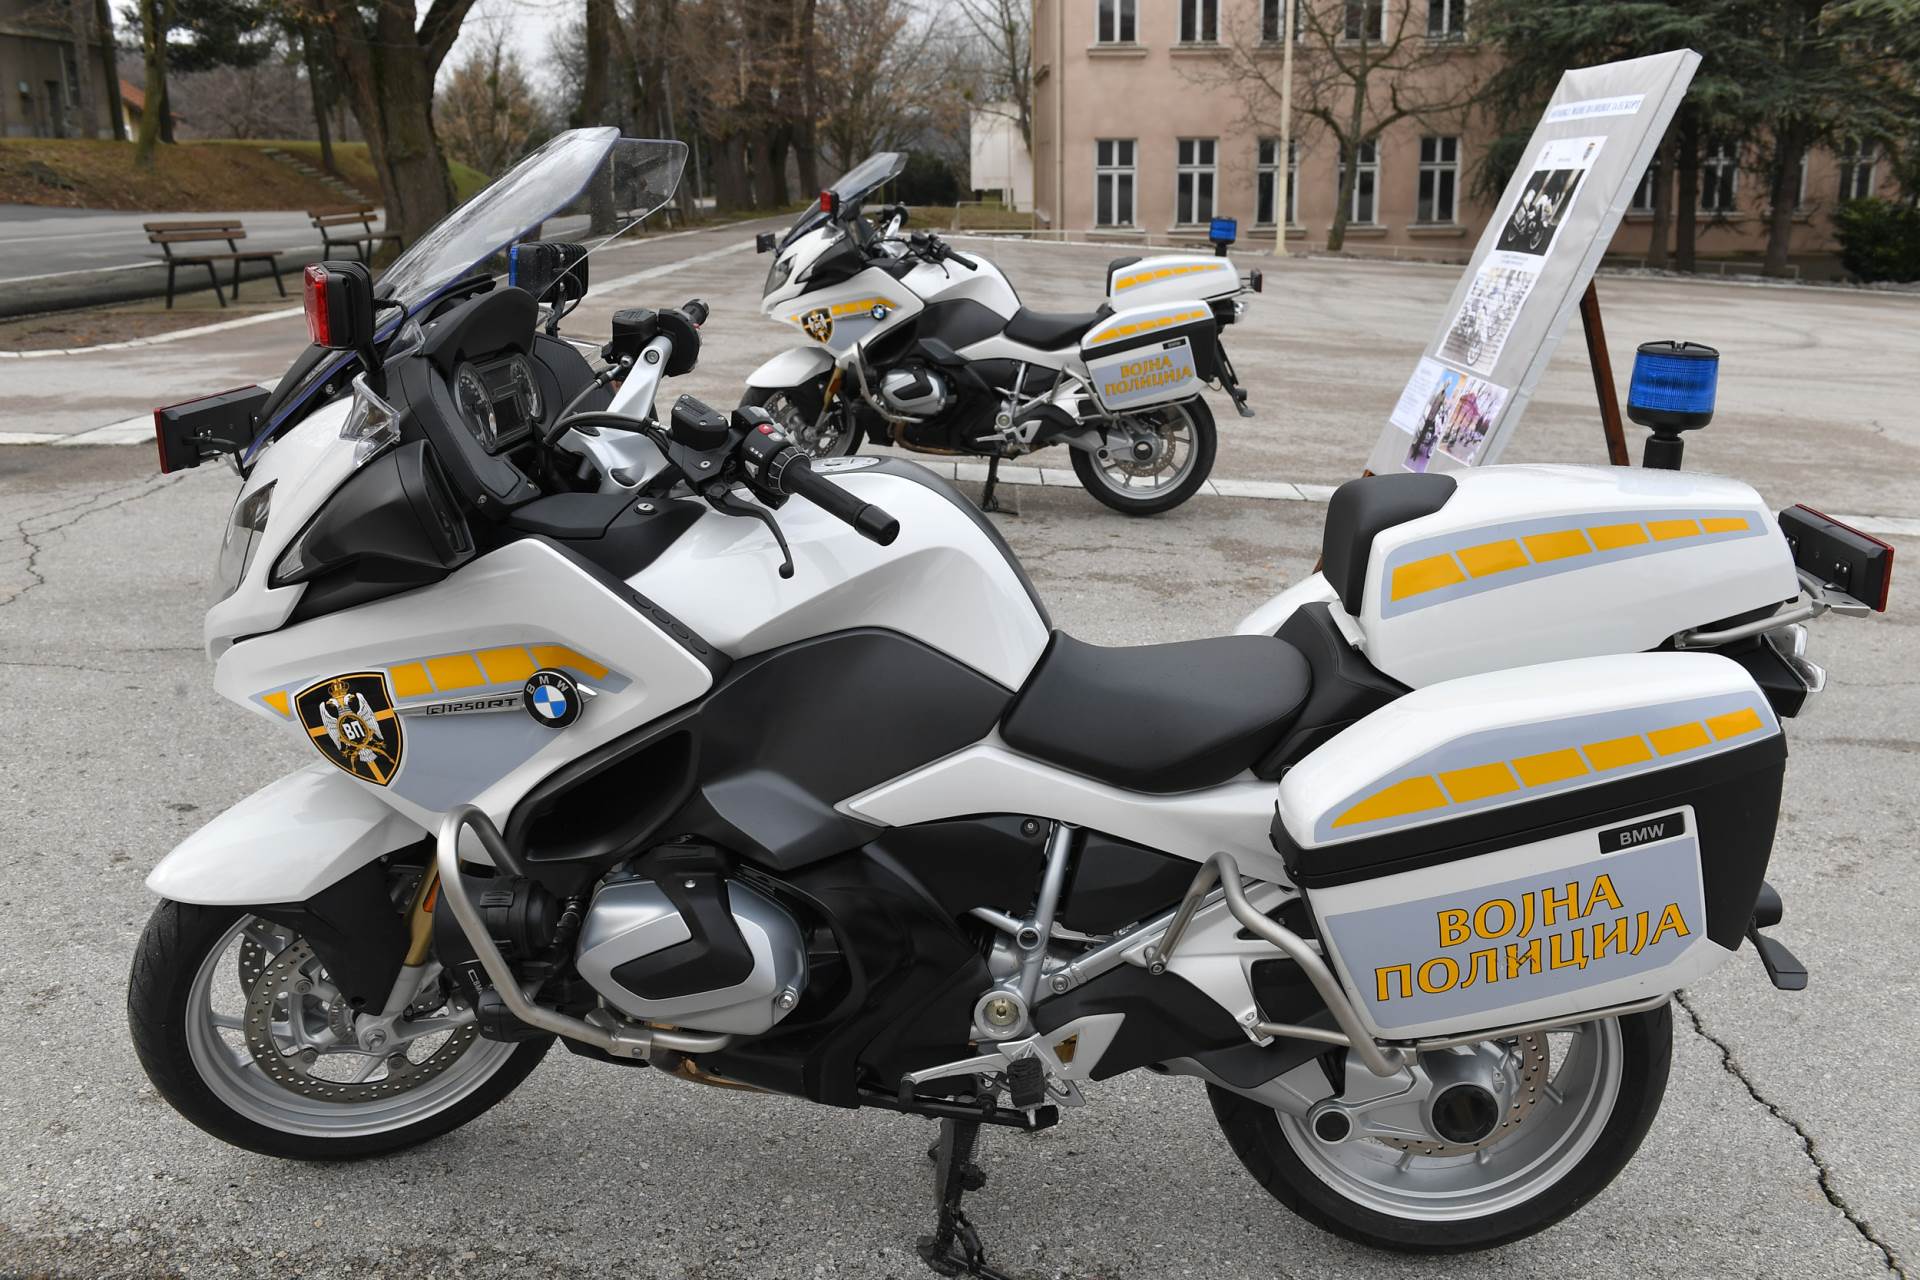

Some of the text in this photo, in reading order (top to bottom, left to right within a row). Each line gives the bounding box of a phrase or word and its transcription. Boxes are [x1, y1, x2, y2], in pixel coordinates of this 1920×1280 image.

[526, 675, 569, 695] BMW
[342, 720, 366, 740] ВП
[1620, 823, 1664, 846] BMW
[1437, 874, 1624, 948] ВОЈНА
[1375, 903, 1691, 1002] ПОЛИЦИЈА
